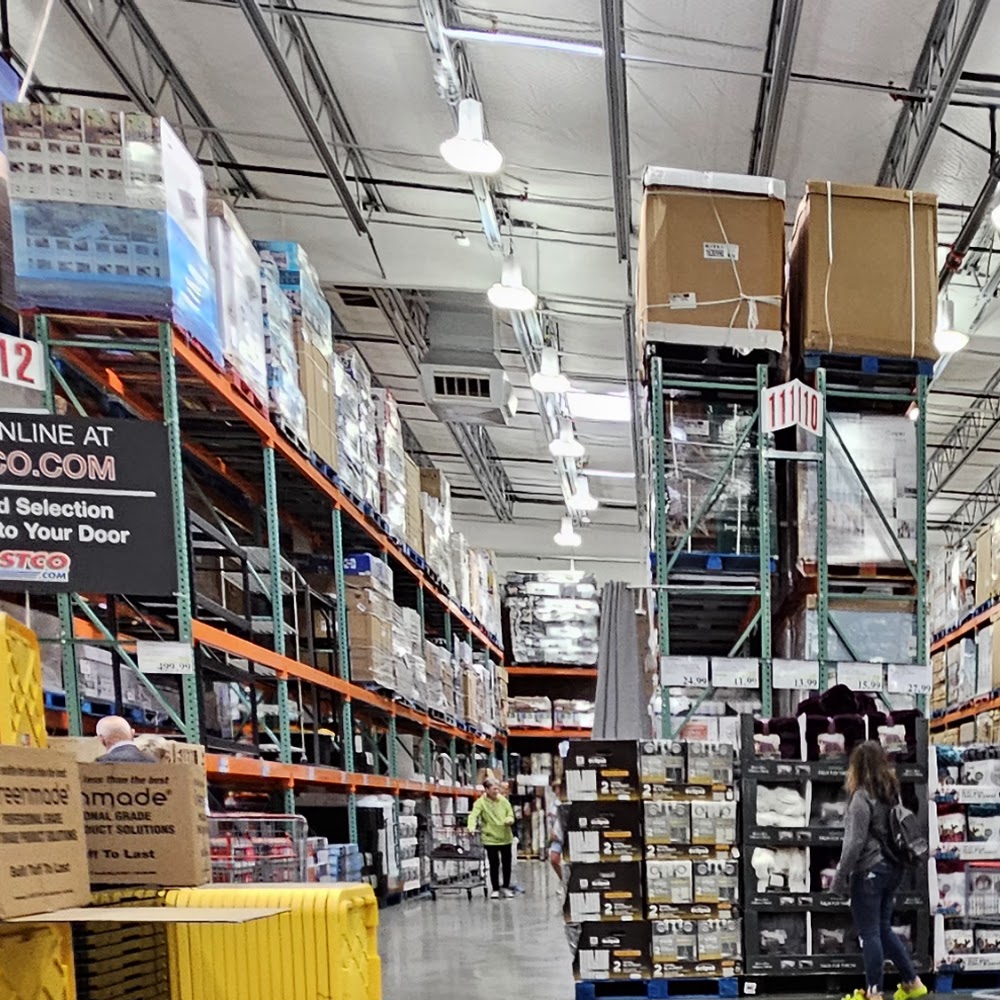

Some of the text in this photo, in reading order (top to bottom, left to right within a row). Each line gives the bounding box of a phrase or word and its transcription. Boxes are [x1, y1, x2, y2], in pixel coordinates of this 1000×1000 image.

[769, 385, 795, 428] 111
[0, 421, 114, 447] NLINE AT
[15, 496, 115, 520] Selection
[0, 521, 131, 544] to Your Door
[115, 811, 152, 821] GRADE
[116, 824, 176, 835] SOLUTIONS
[102, 849, 120, 859] To
[124, 849, 156, 859] Last
